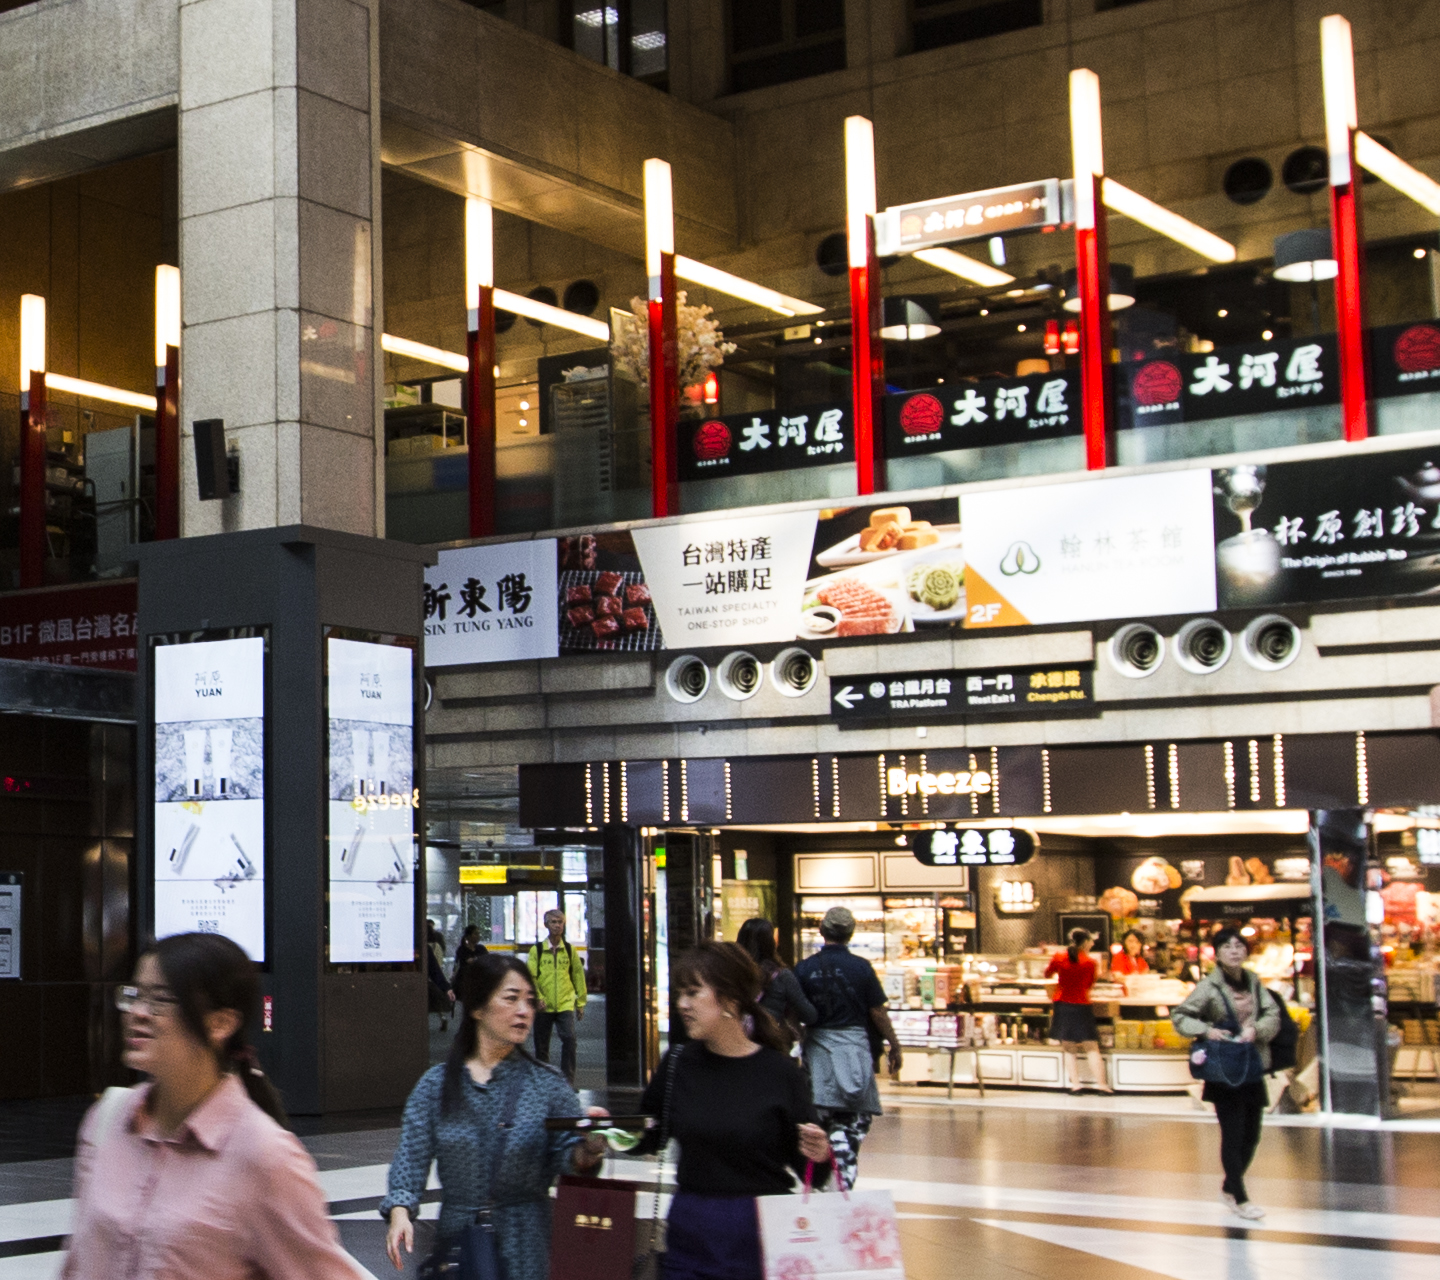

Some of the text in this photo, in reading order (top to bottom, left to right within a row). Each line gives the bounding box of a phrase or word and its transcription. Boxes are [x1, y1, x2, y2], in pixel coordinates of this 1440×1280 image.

[1190, 343, 1323, 396] 大河屋
[950, 379, 1069, 426] 大河屋
[739, 408, 844, 451] 大河屋
[682, 536, 773, 568] 台灣特產
[1282, 548, 1408, 569] The Origin of Bubble Tea
[682, 567, 773, 596] 一站購足
[678, 600, 779, 617] TAIWAN SPECIALTY
[970, 603, 1002, 623] 2F
[454, 620, 492, 634] TUNG
[497, 615, 534, 630] YANG
[688, 616, 770, 631] ONE-STOP SHOP
[0, 624, 34, 646] B1F
[195, 687, 223, 698] YUAN
[966, 673, 1014, 692] 西一門
[360, 689, 382, 700] YUAN
[890, 699, 909, 709] TRA
[909, 698, 947, 709] Platform
[968, 695, 990, 705] West
[989, 694, 1009, 704] Exit
[1027, 691, 1068, 703] Chengde
[887, 767, 992, 796] Breeze
